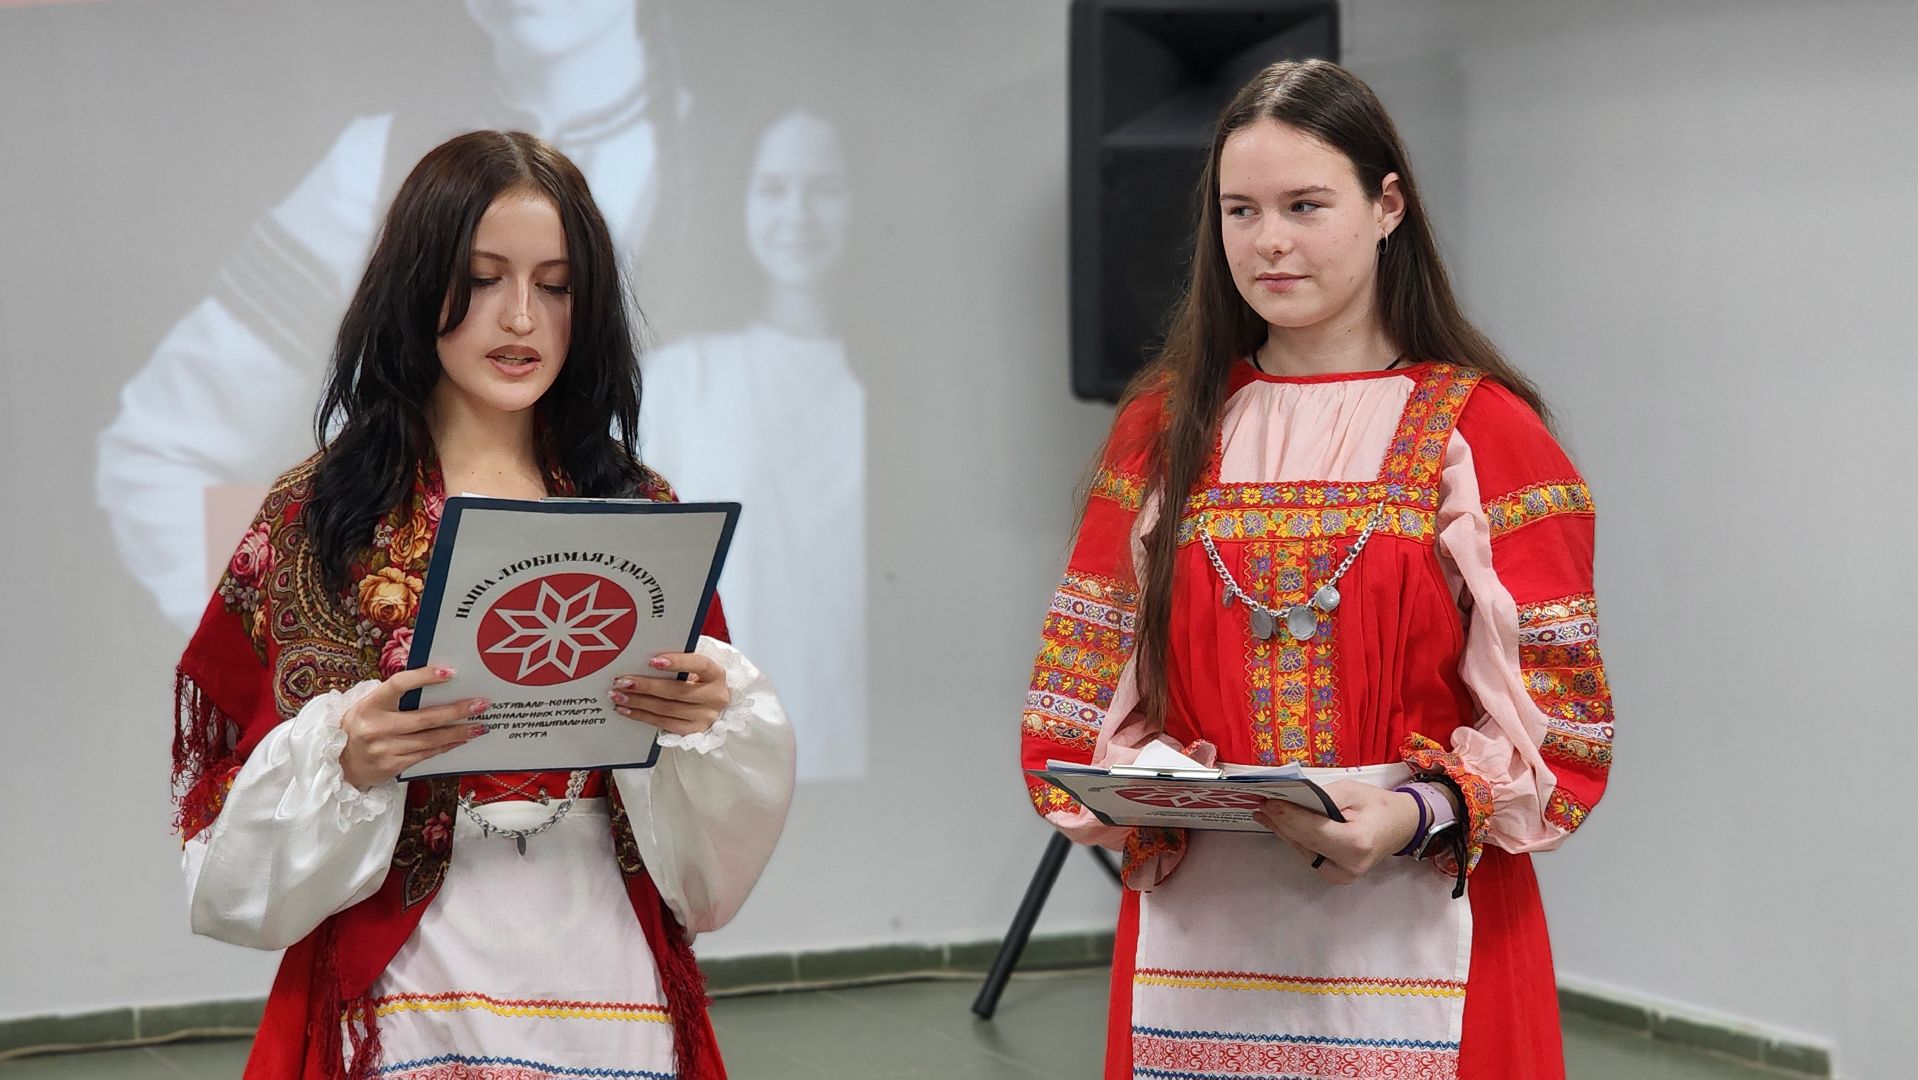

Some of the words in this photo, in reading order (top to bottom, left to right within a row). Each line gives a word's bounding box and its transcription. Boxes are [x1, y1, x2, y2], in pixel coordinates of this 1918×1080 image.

[455, 578, 495, 619] НАША
[498, 551, 606, 580] ЛЮБИМАЯ
[604, 554, 665, 618] УДМУРТИЯ!
[490, 697, 598, 710] ЕСТИВАЛЬ-КОНКУРС
[468, 710, 553, 722] НАЦИОНАЛЬНЫХ
[555, 707, 602, 717] КУЛЬТУР
[512, 717, 606, 729] МУНИЦИПАЛЬНОГО
[508, 731, 547, 739] ОКРУГА
